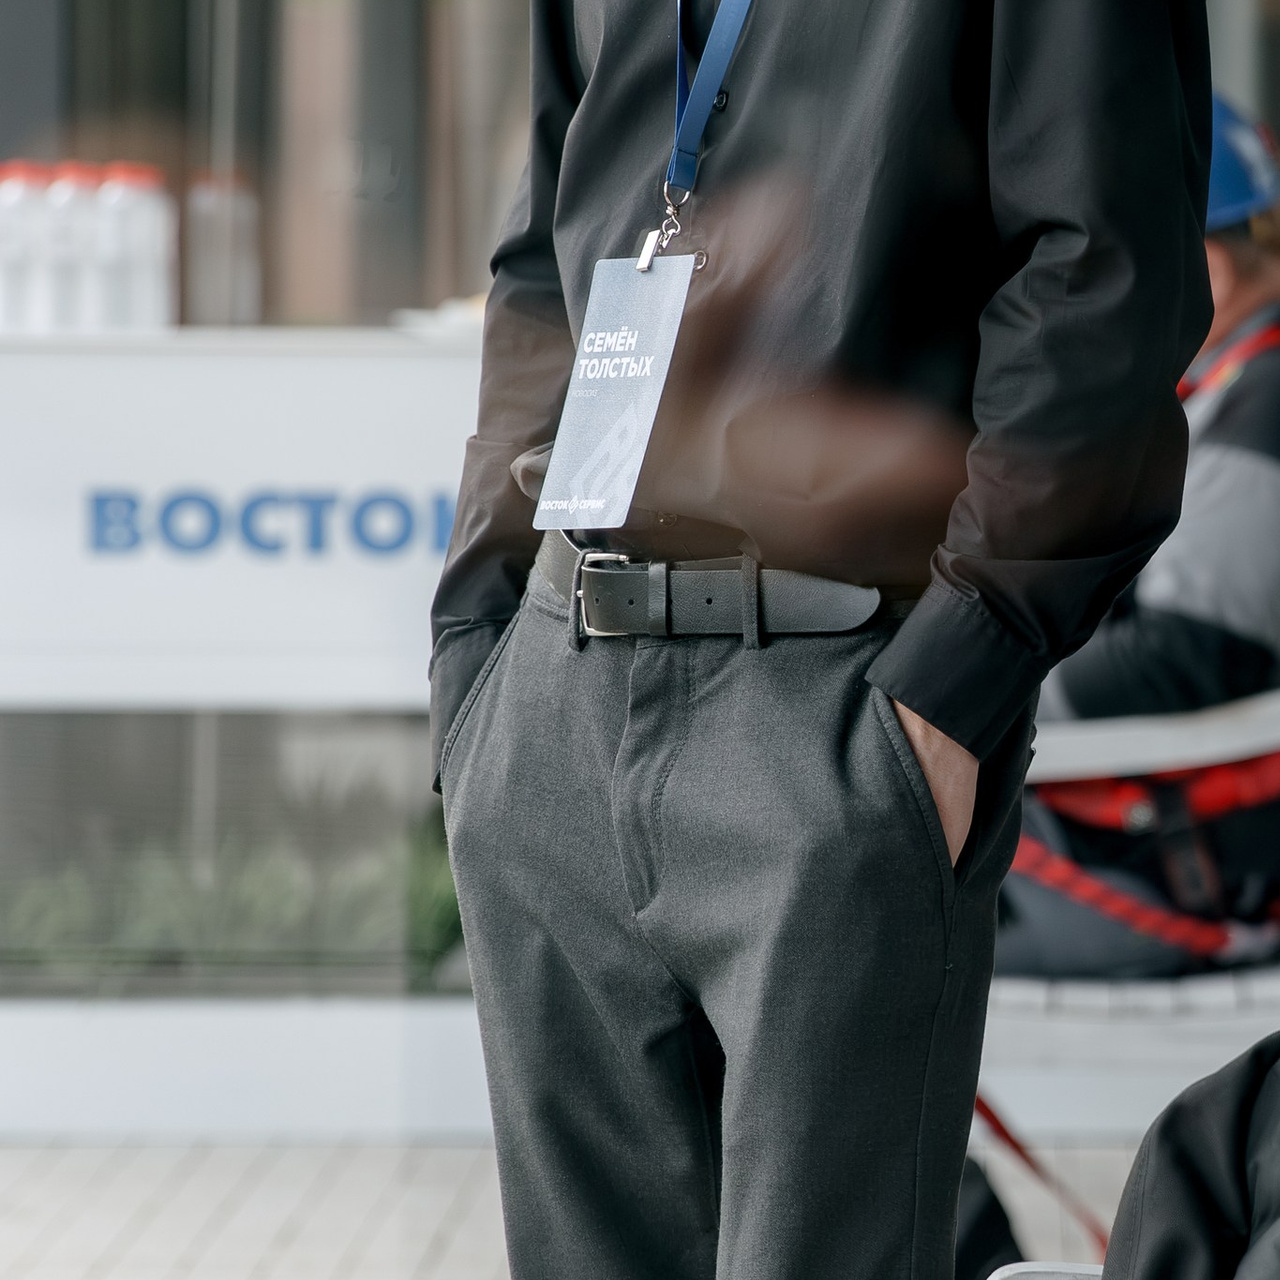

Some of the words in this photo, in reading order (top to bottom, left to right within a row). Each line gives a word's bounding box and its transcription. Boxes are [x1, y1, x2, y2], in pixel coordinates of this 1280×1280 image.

[583, 326, 639, 353] СЕМЁН
[578, 355, 655, 379] ТОЛСТЫХ
[540, 500, 569, 511] ВОСТОК
[579, 499, 606, 510] СЕРВИС
